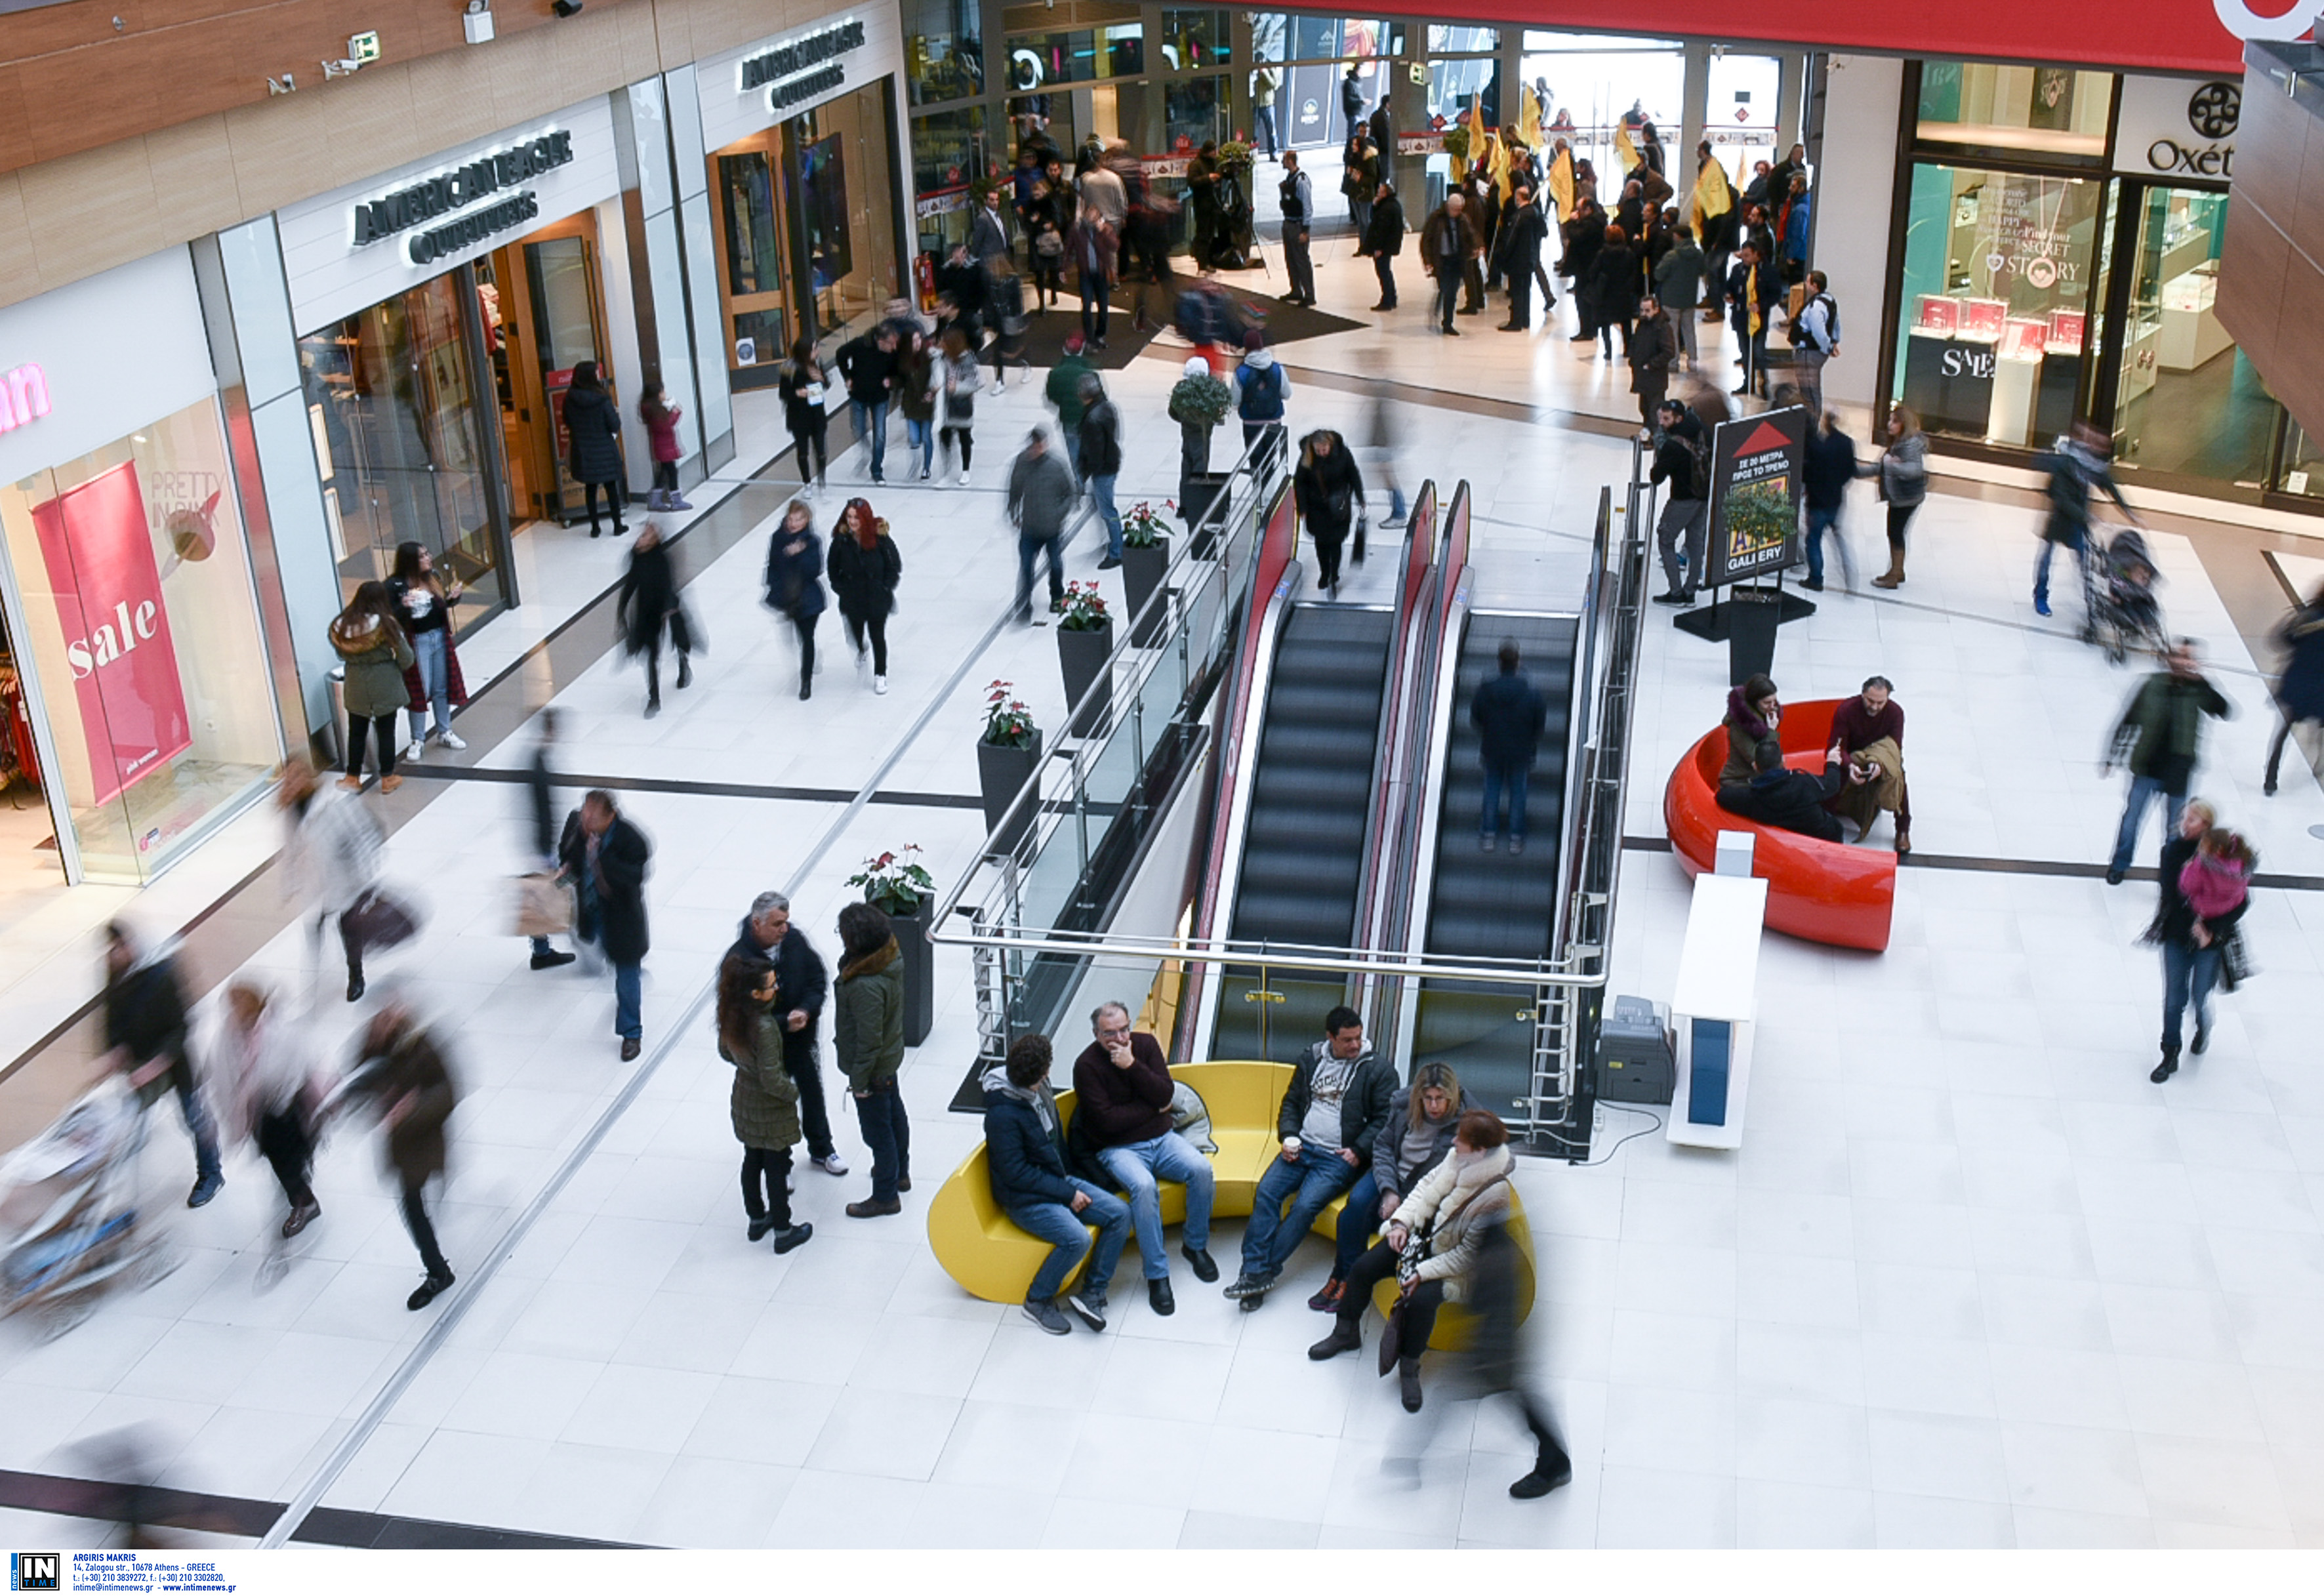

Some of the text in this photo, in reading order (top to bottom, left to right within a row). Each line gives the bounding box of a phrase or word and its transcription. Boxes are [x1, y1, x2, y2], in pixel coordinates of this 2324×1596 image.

[354, 131, 573, 245] AMERICAN EAGLE
[409, 190, 539, 264] OUTFITTERS
[152, 472, 225, 499] PRETTY
[68, 600, 157, 682] sale
